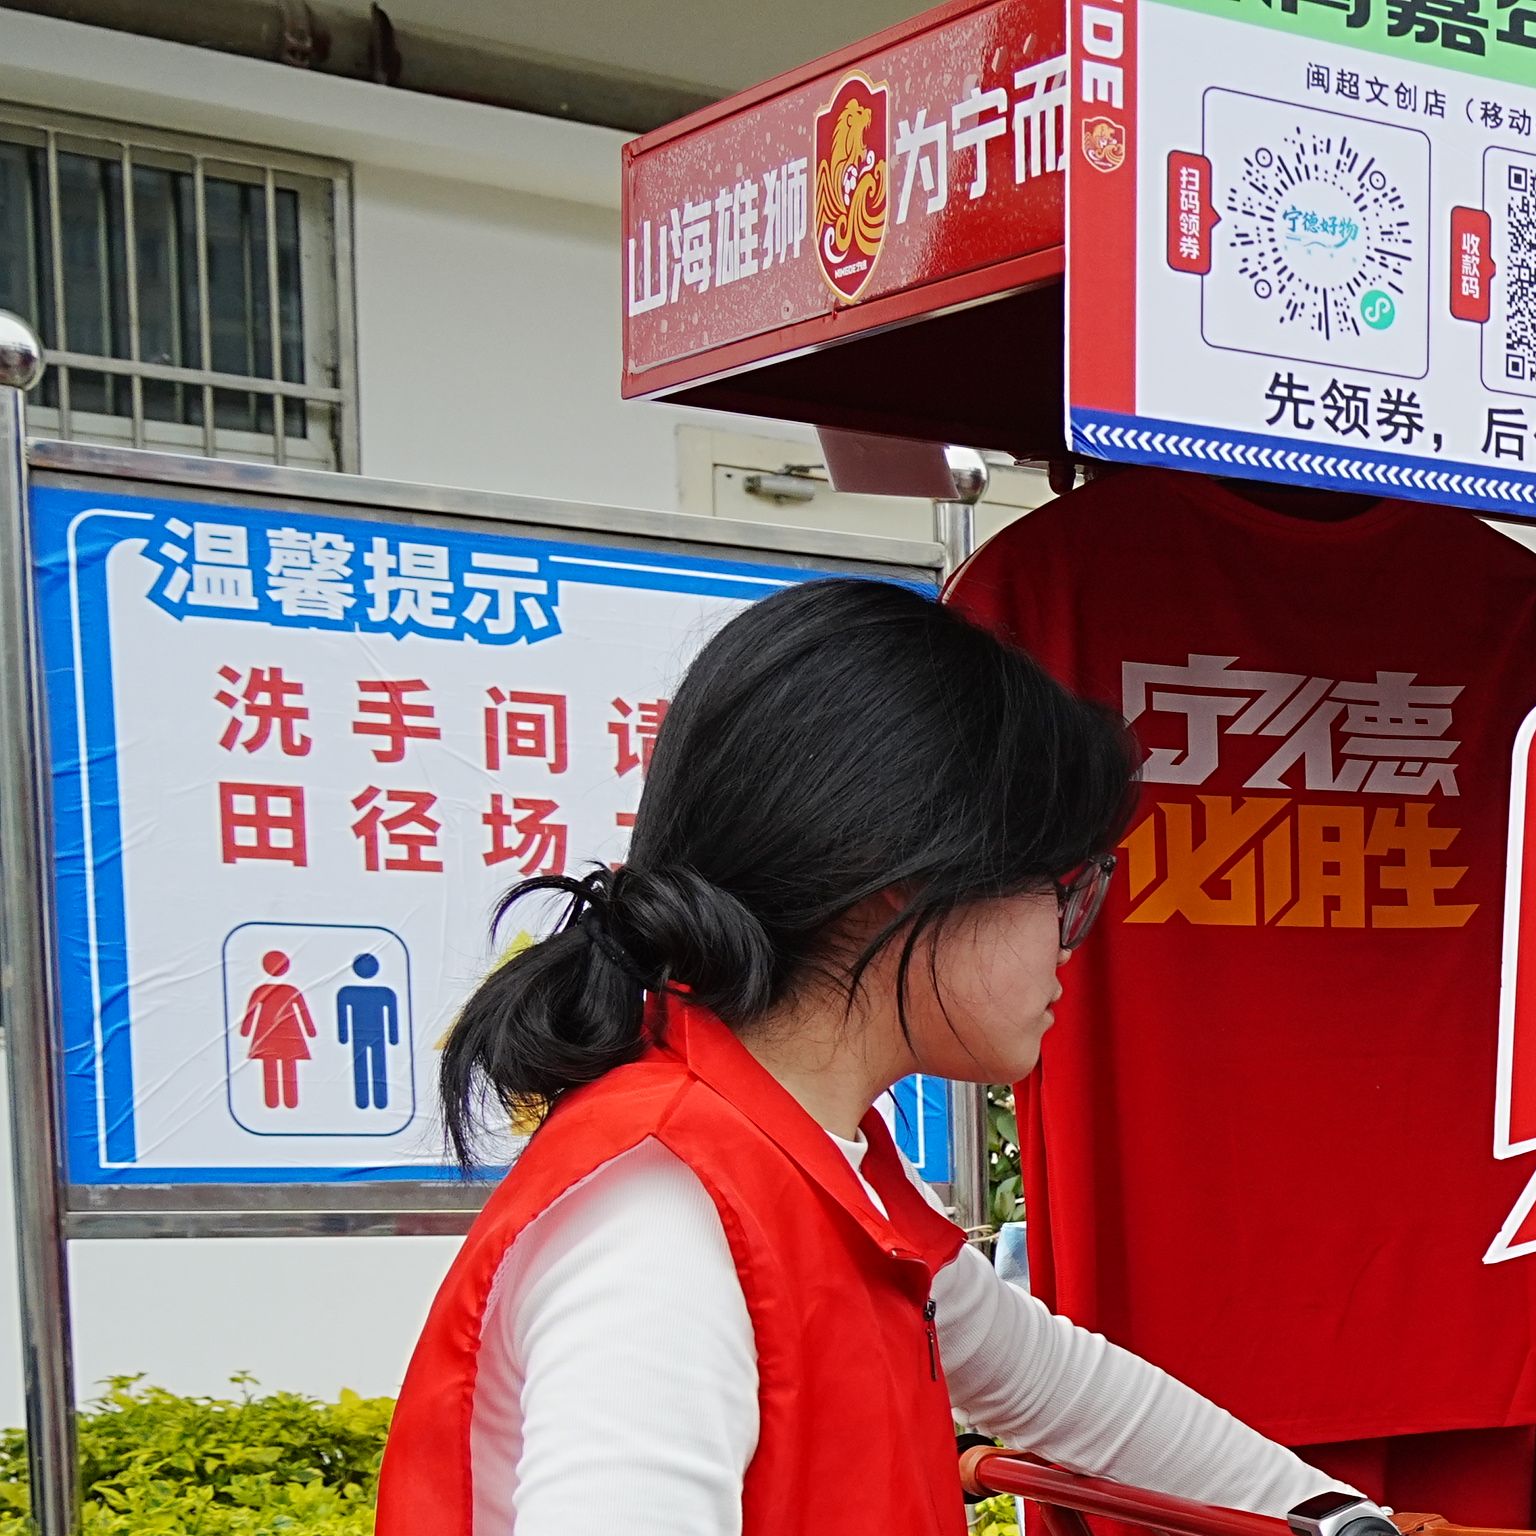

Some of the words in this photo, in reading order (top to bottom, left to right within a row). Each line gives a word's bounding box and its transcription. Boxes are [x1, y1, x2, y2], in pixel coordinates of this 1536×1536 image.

[1082, 0, 1124, 110] DE
[629, 157, 808, 317] 山海雄狮
[1179, 166, 1201, 260] 扫码领券
[1459, 231, 1482, 300] 收款码
[164, 519, 550, 635] 温馨提示
[1121, 653, 1466, 796] 宁德
[219, 782, 636, 878] 田径场
[1117, 794, 1480, 929] 必胜
